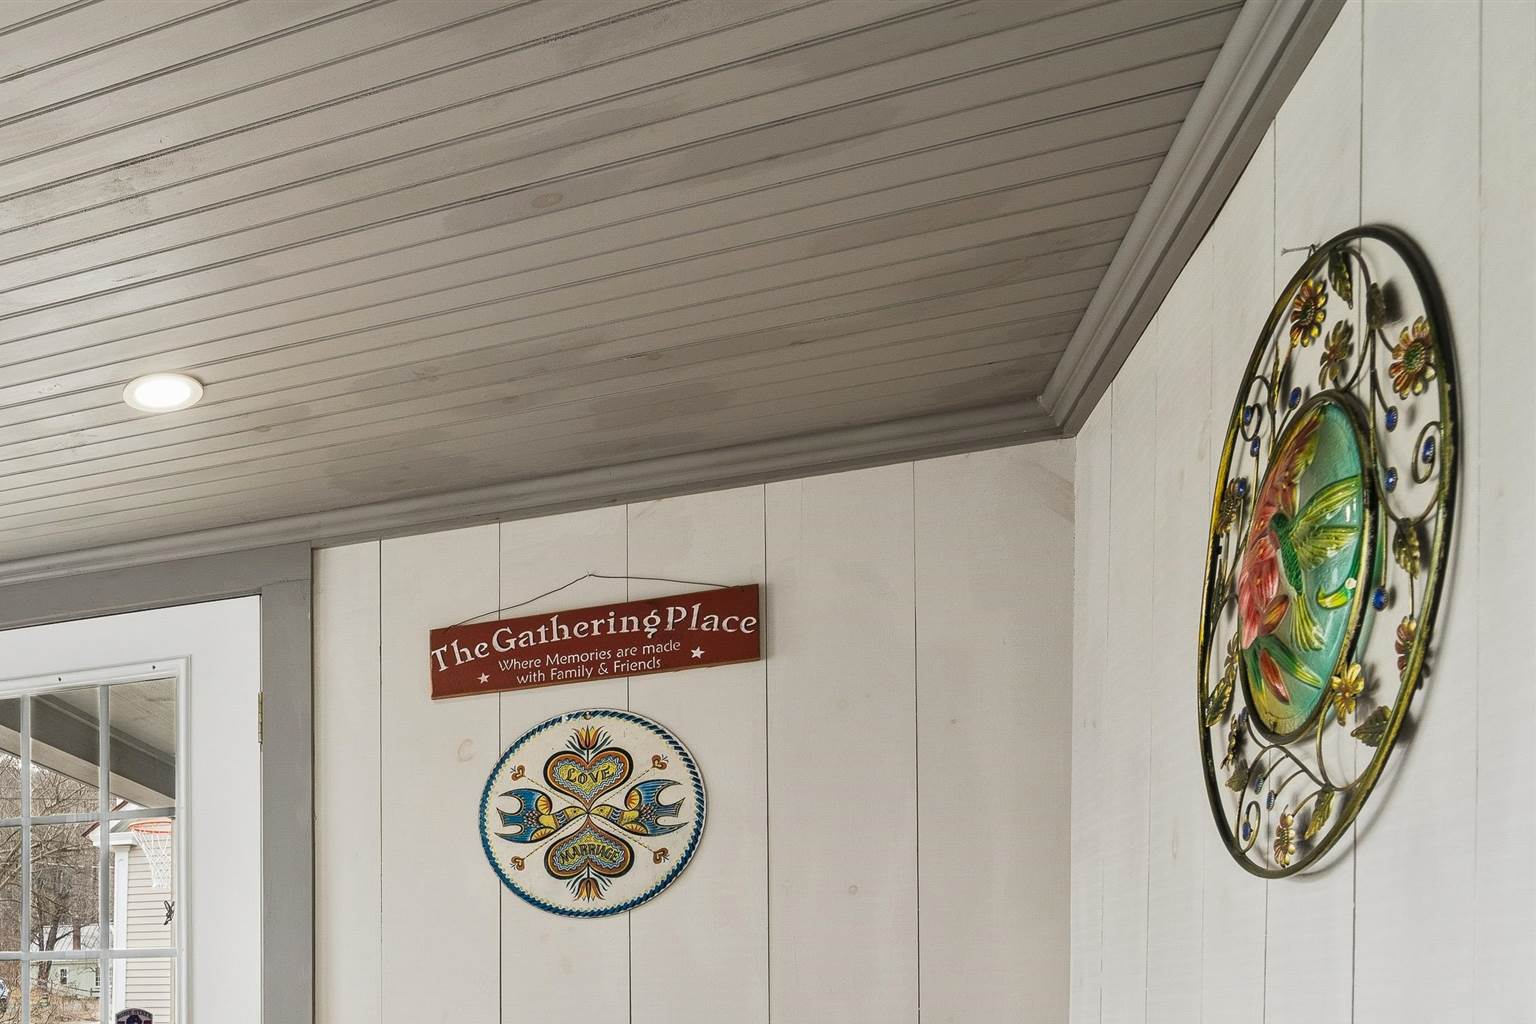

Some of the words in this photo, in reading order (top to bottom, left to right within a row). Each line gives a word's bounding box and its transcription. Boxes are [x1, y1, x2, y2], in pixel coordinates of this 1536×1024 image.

[431, 638, 490, 672] The
[492, 609, 661, 653] Gathering
[663, 602, 757, 634] Place
[498, 656, 542, 672] Where
[545, 648, 612, 667] Memories
[616, 645, 637, 658] are
[642, 639, 681, 655] made
[516, 669, 546, 685] with
[550, 664, 594, 681] Family
[597, 663, 609, 675] &
[613, 656, 662, 673] Friends
[565, 767, 614, 785] LOVE
